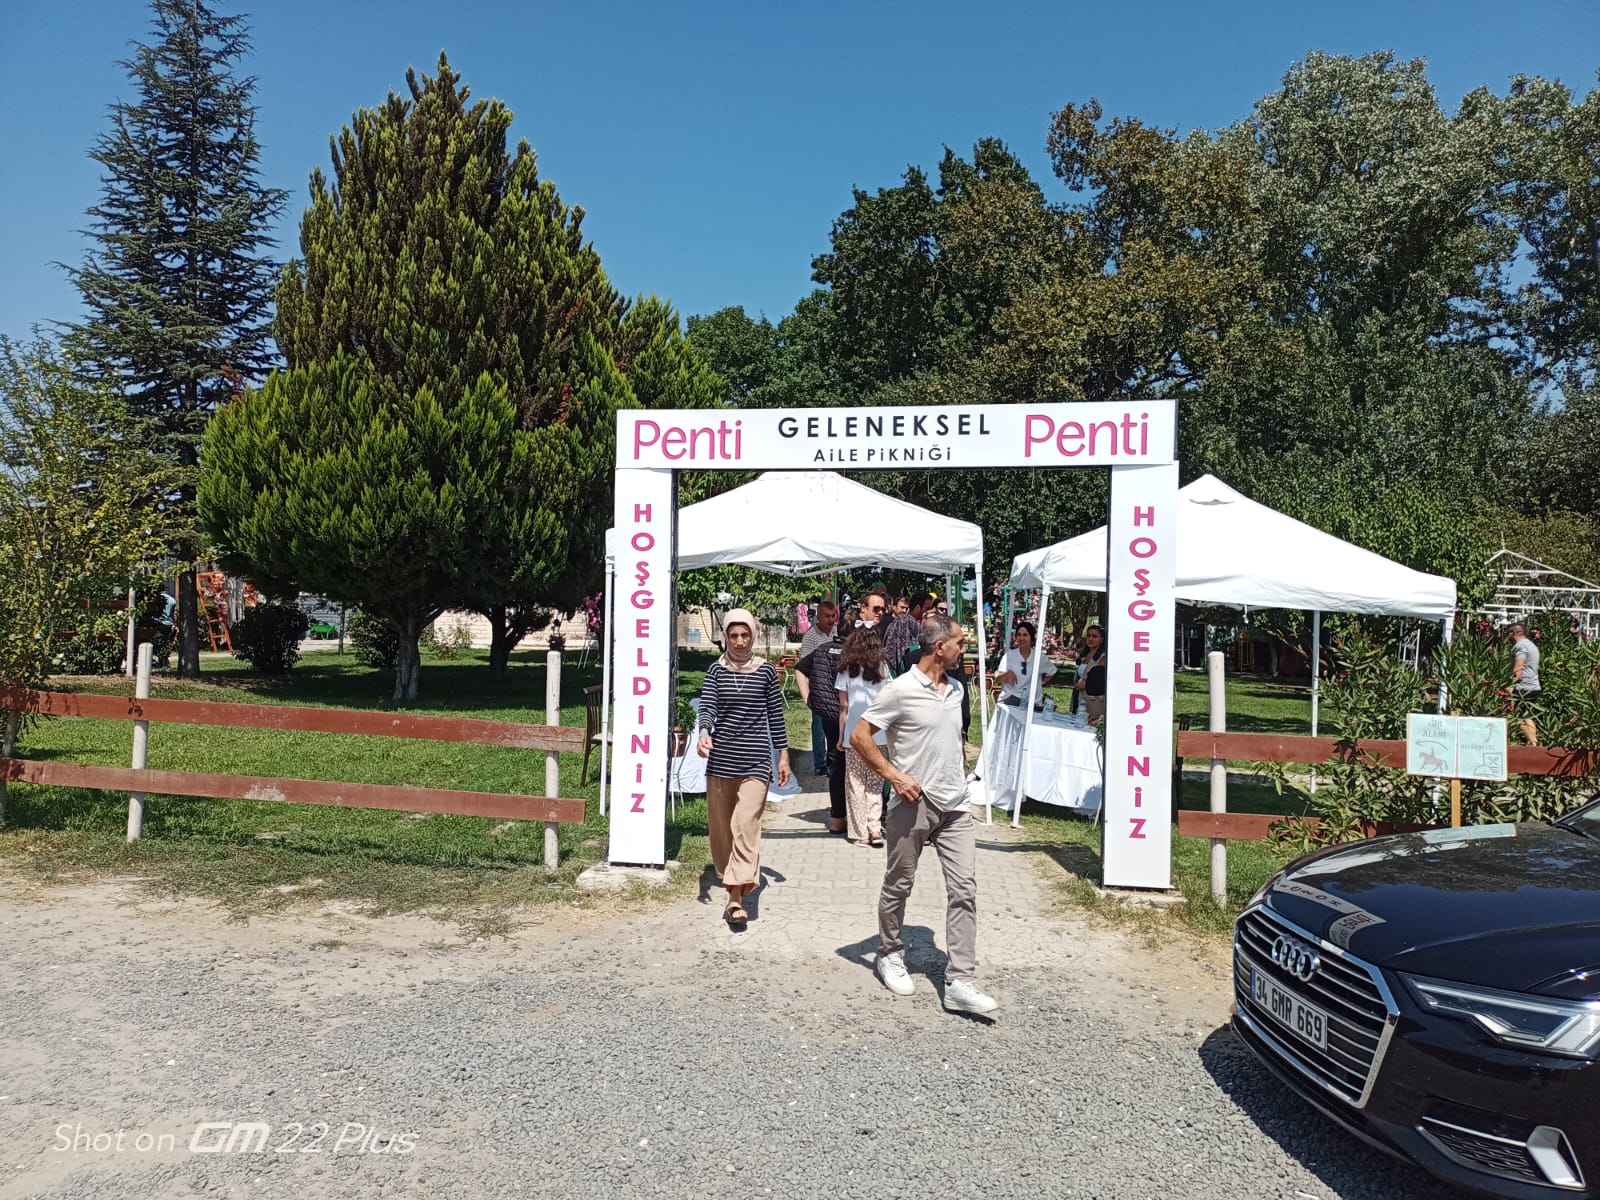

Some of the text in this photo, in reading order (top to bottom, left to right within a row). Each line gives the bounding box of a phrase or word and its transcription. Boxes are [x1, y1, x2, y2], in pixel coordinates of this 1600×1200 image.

[634, 419, 742, 461] Penti
[778, 413, 991, 439] GELENEKSEL
[1024, 412, 1148, 458] Penti
[1256, 976, 1323, 1043] 34 GMR 669
